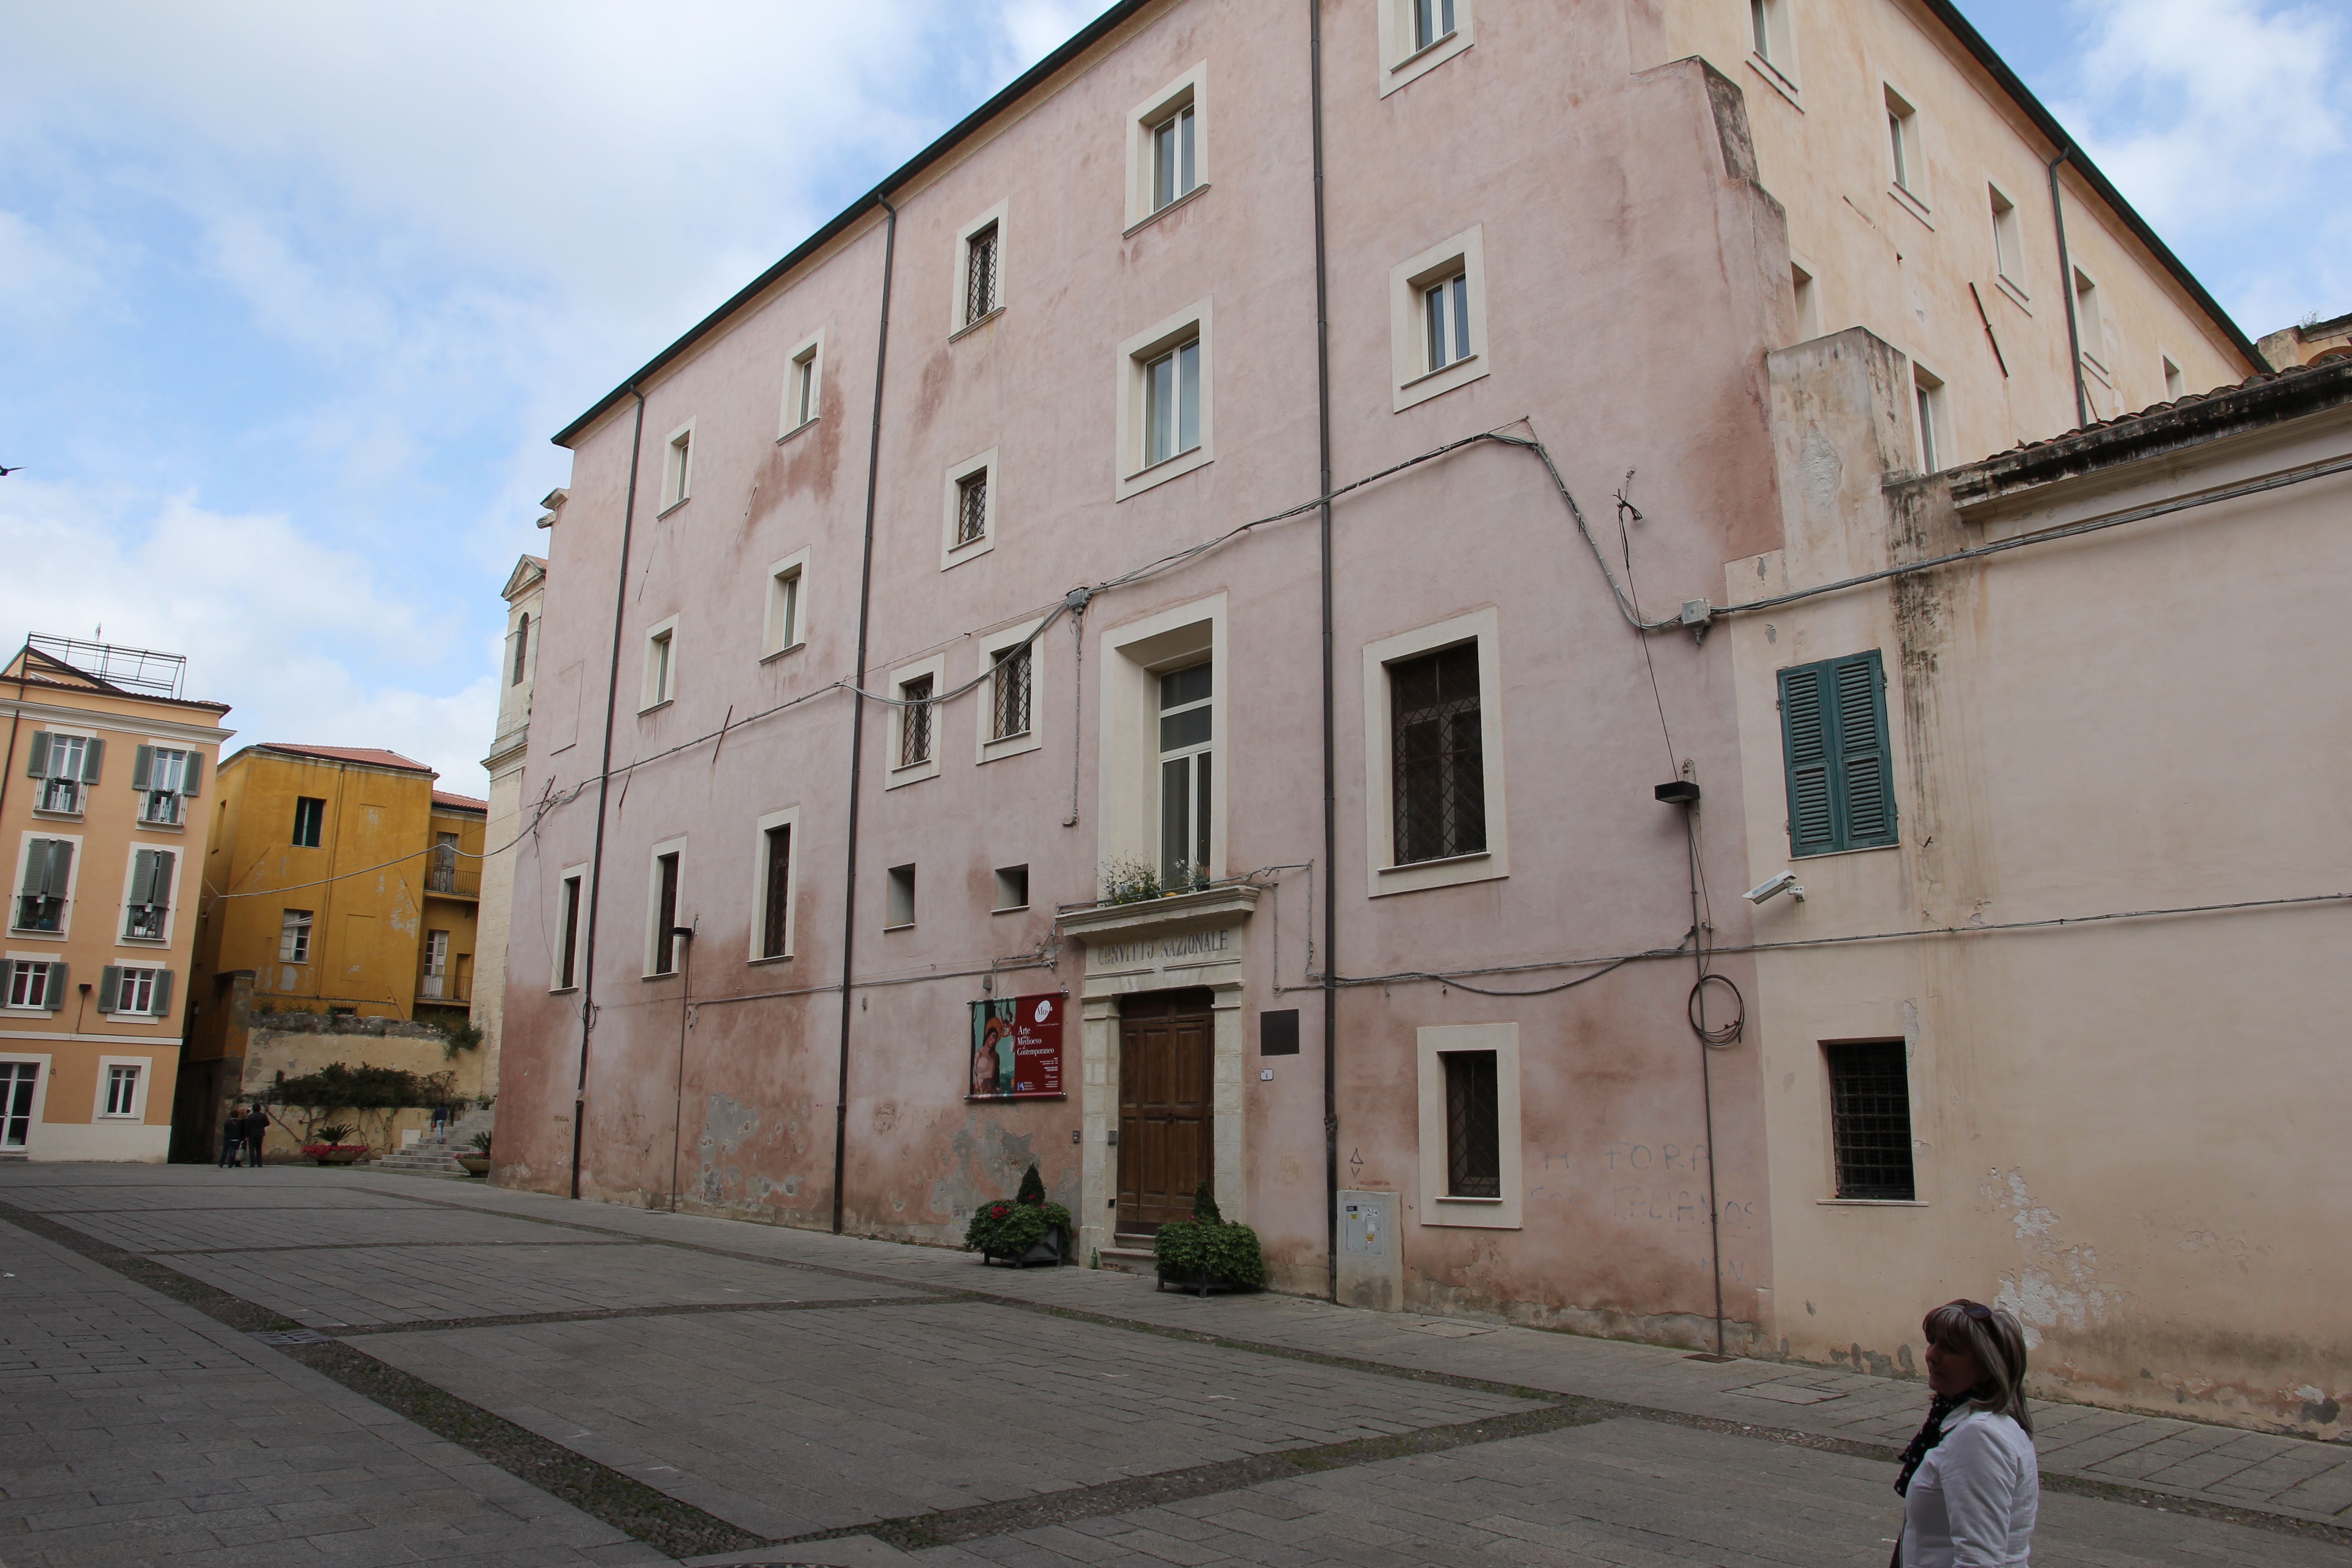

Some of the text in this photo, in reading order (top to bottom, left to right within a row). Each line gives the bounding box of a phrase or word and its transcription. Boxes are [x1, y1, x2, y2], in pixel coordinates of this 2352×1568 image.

[1160, 929, 1228, 958] NAZIONALE
[1018, 1026, 1030, 1034] Arte
[1017, 1036, 1042, 1045] Medioevo
[1017, 1048, 1054, 1057] Contemporaneo
